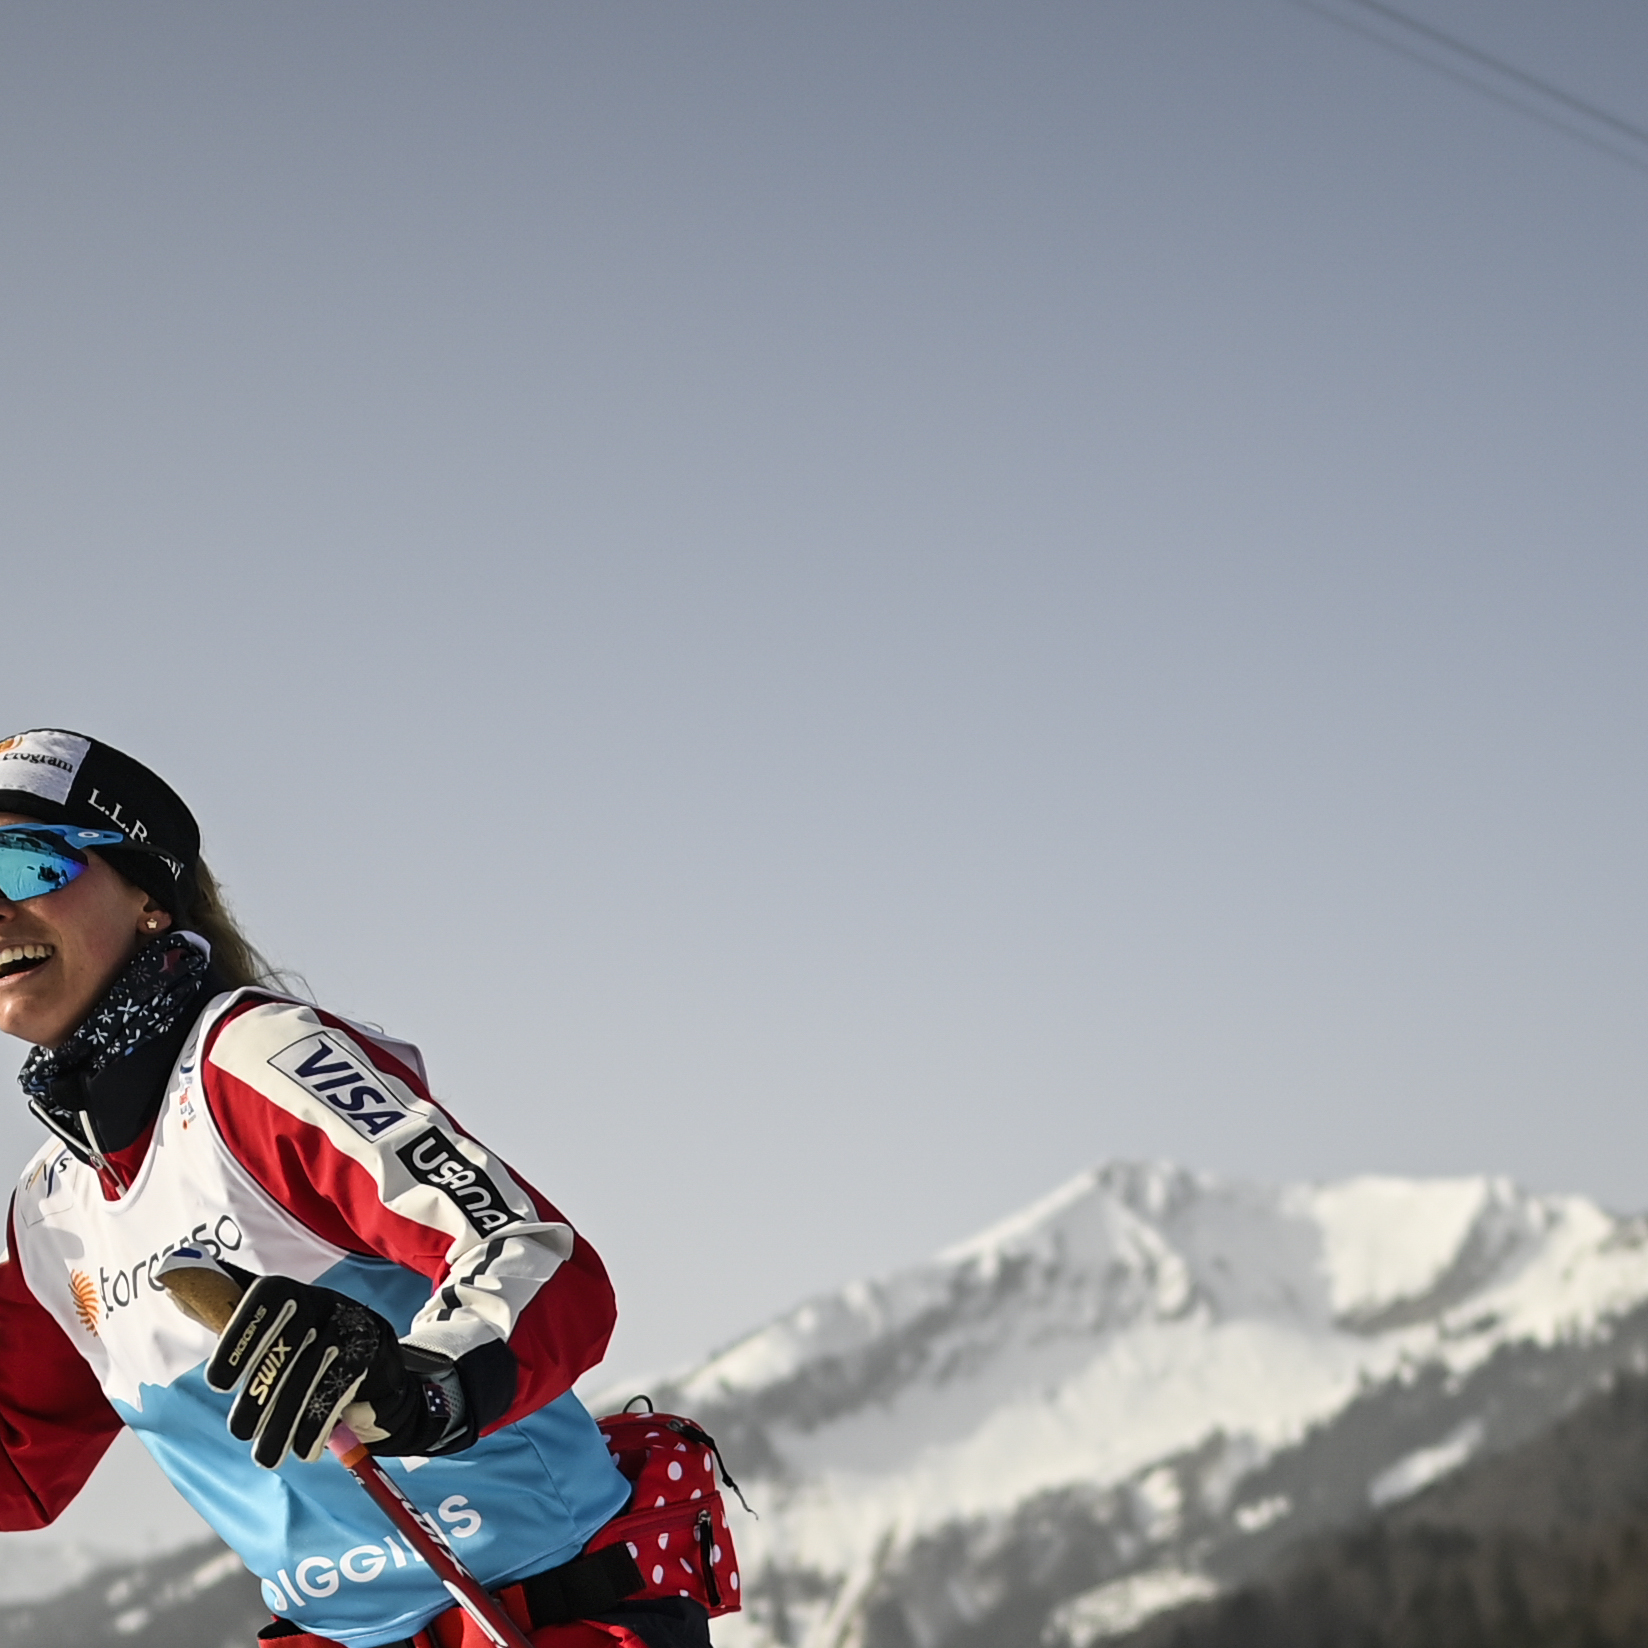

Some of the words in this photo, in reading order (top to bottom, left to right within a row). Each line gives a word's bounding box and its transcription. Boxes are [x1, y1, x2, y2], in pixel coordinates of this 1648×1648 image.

[294, 1038, 407, 1136] VISA
[412, 1136, 508, 1232] USANA
[228, 1304, 269, 1367] DIGGINS
[249, 1337, 292, 1406] SWIX
